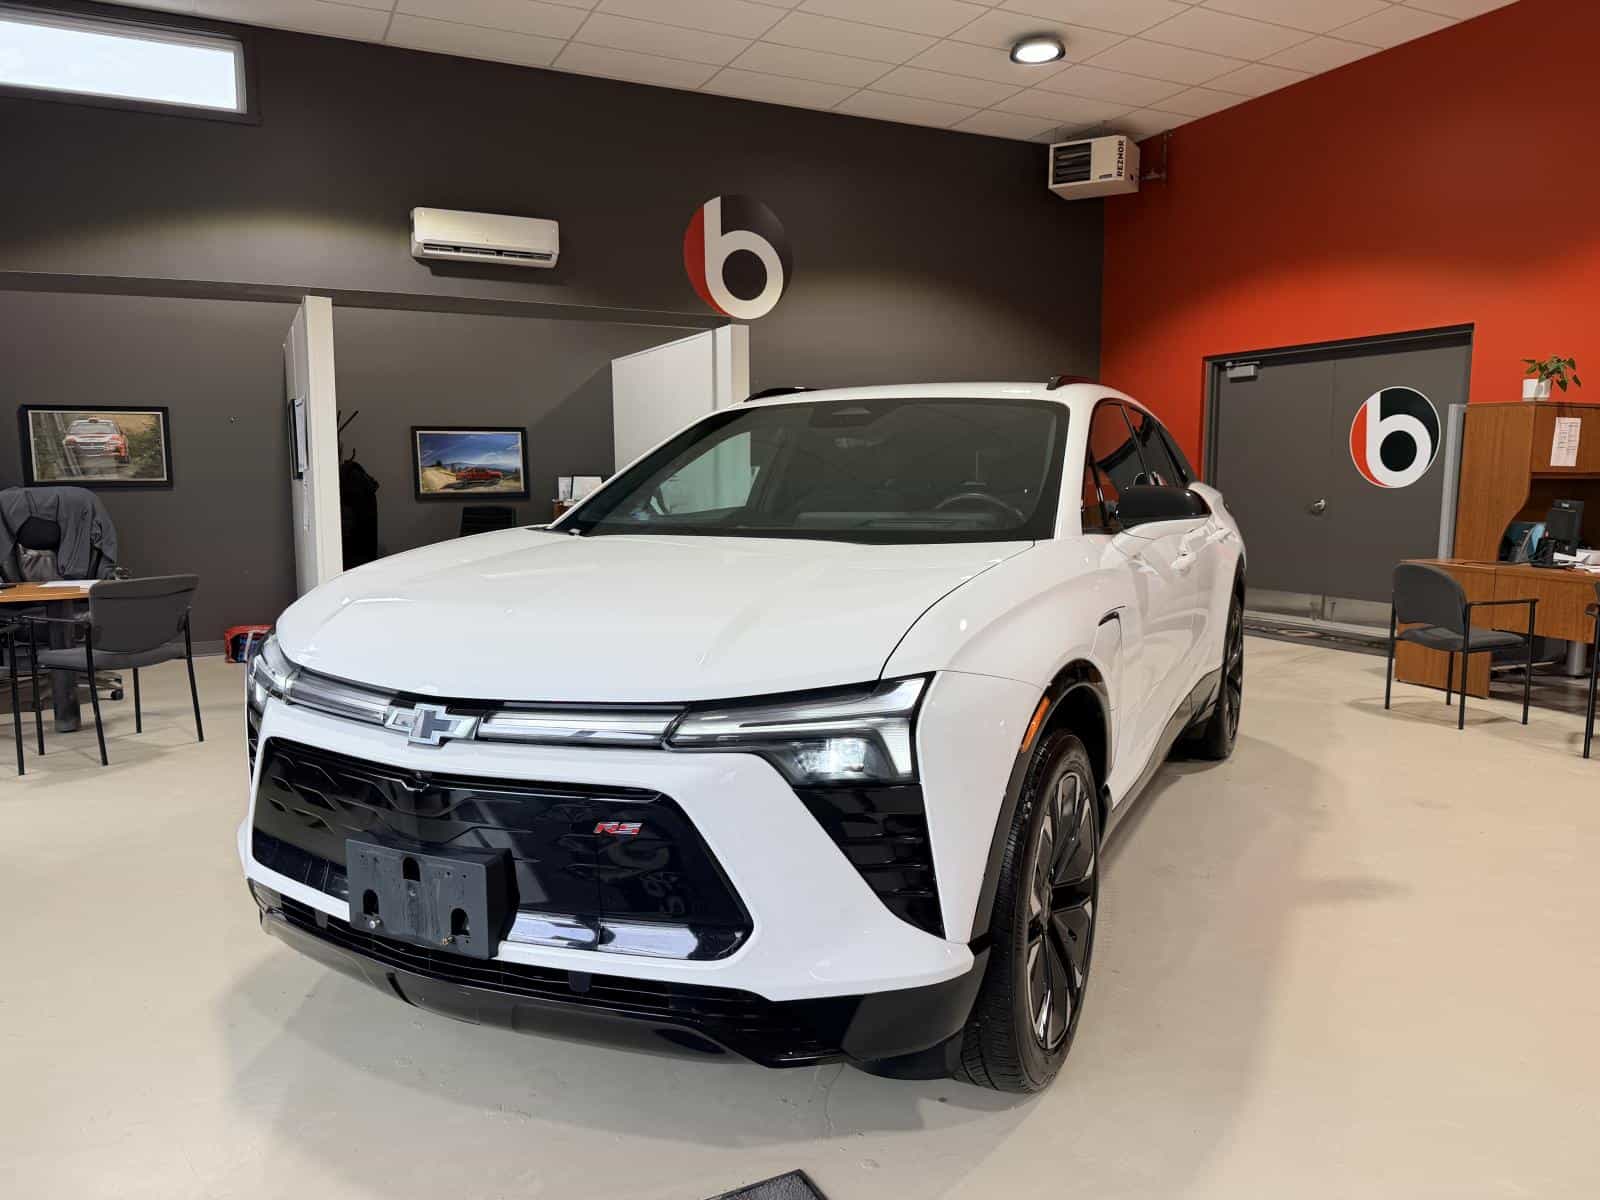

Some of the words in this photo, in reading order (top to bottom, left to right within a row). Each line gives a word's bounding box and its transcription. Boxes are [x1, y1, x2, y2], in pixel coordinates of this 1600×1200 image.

[1116, 140, 1125, 177] REZNOR
[703, 196, 784, 320] b
[1366, 390, 1432, 488] b
[593, 822, 643, 835] RS
